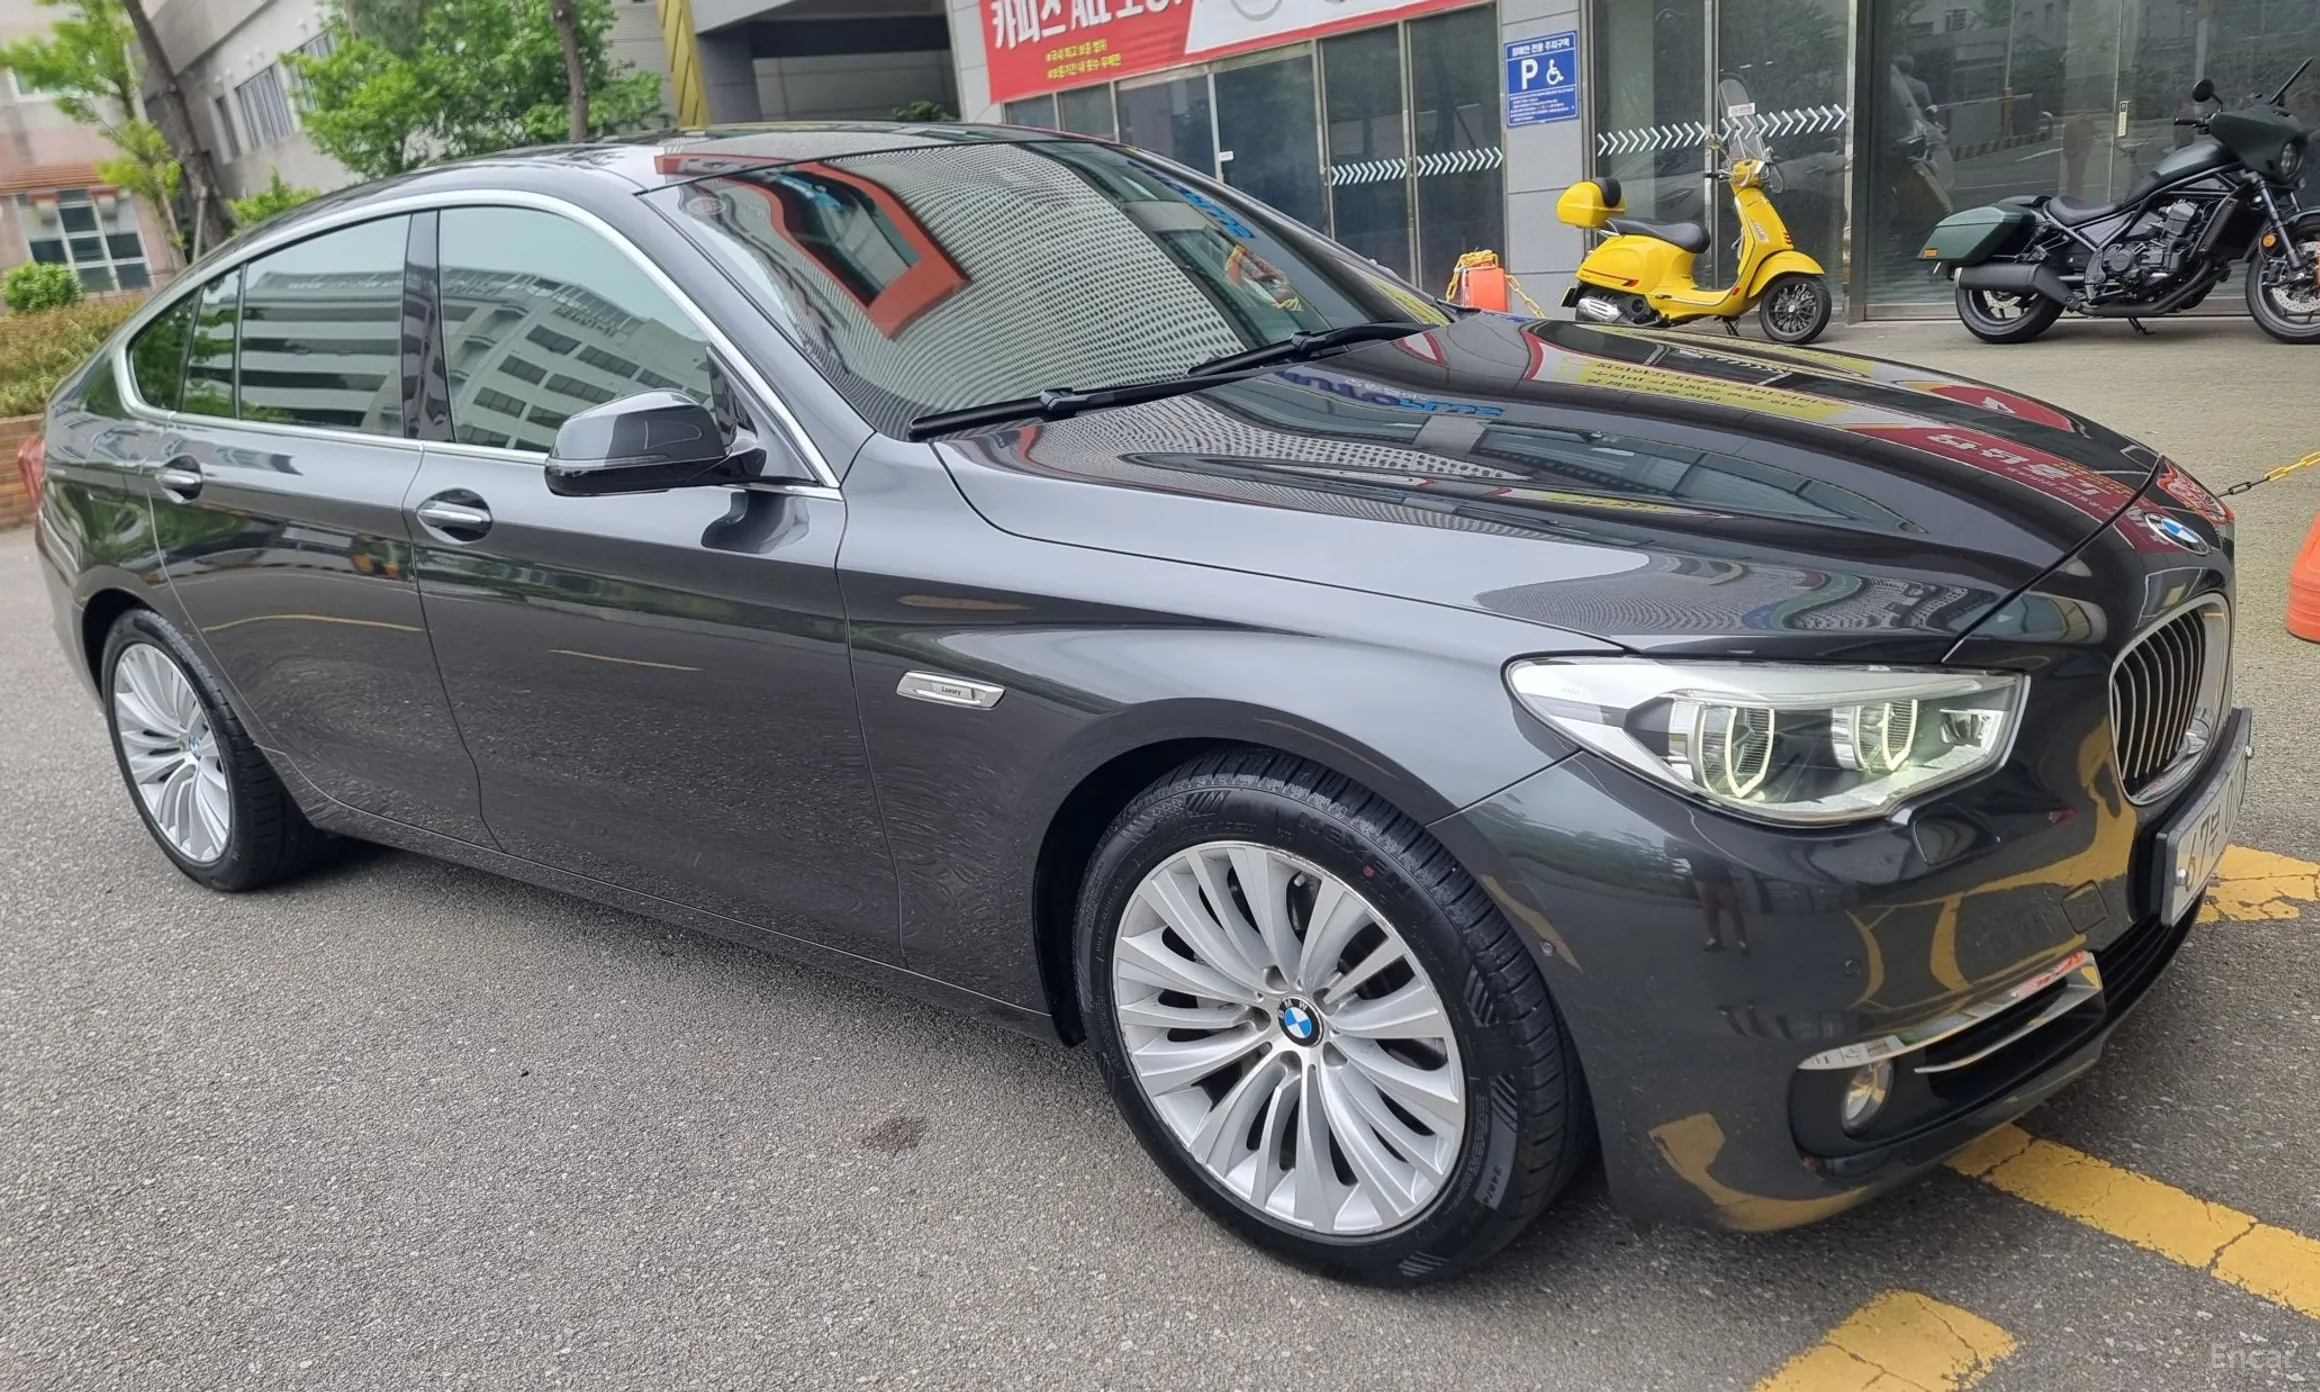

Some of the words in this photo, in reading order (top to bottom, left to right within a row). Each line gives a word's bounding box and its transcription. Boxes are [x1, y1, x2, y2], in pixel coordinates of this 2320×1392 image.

[1521, 58, 1539, 90] P
[941, 686, 962, 696] Luxury
[1278, 998, 1309, 1019] BMW
